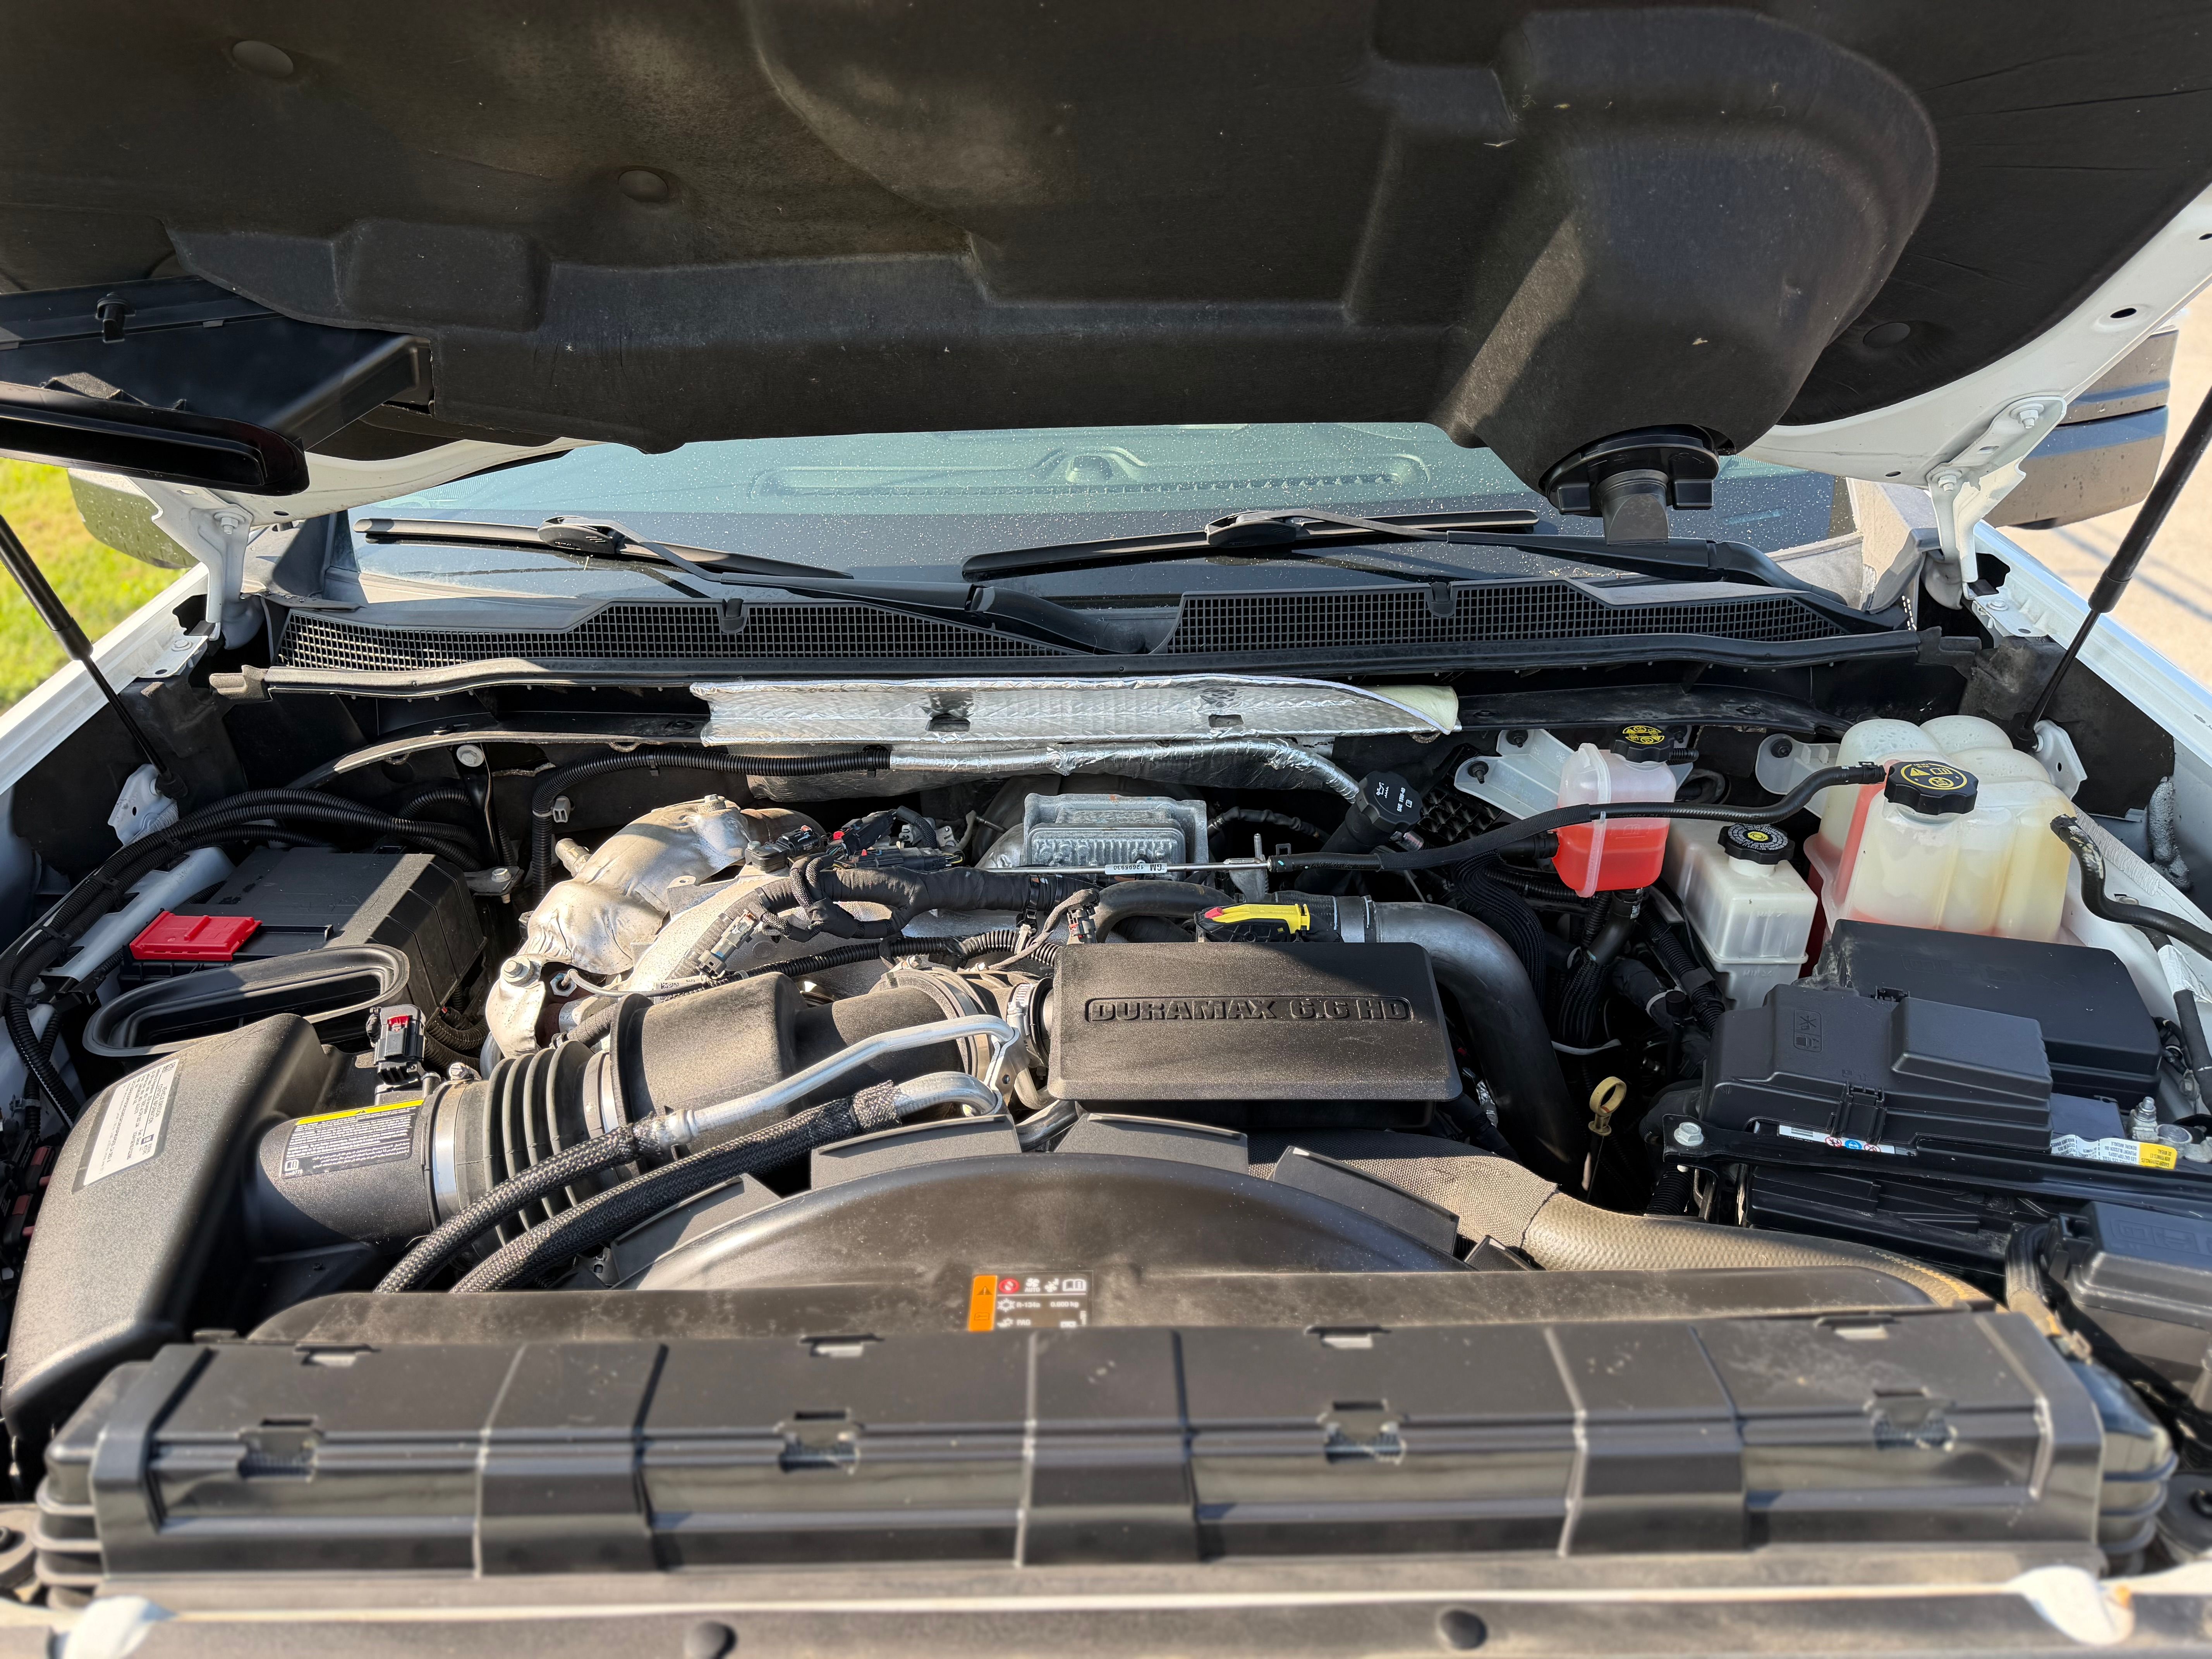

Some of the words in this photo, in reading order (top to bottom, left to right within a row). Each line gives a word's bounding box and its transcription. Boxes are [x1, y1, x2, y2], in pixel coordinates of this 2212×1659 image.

[1090, 998, 1278, 1021] DURAMAX
[1290, 999, 1350, 1020] 6.6
[1359, 999, 1407, 1021] HD
